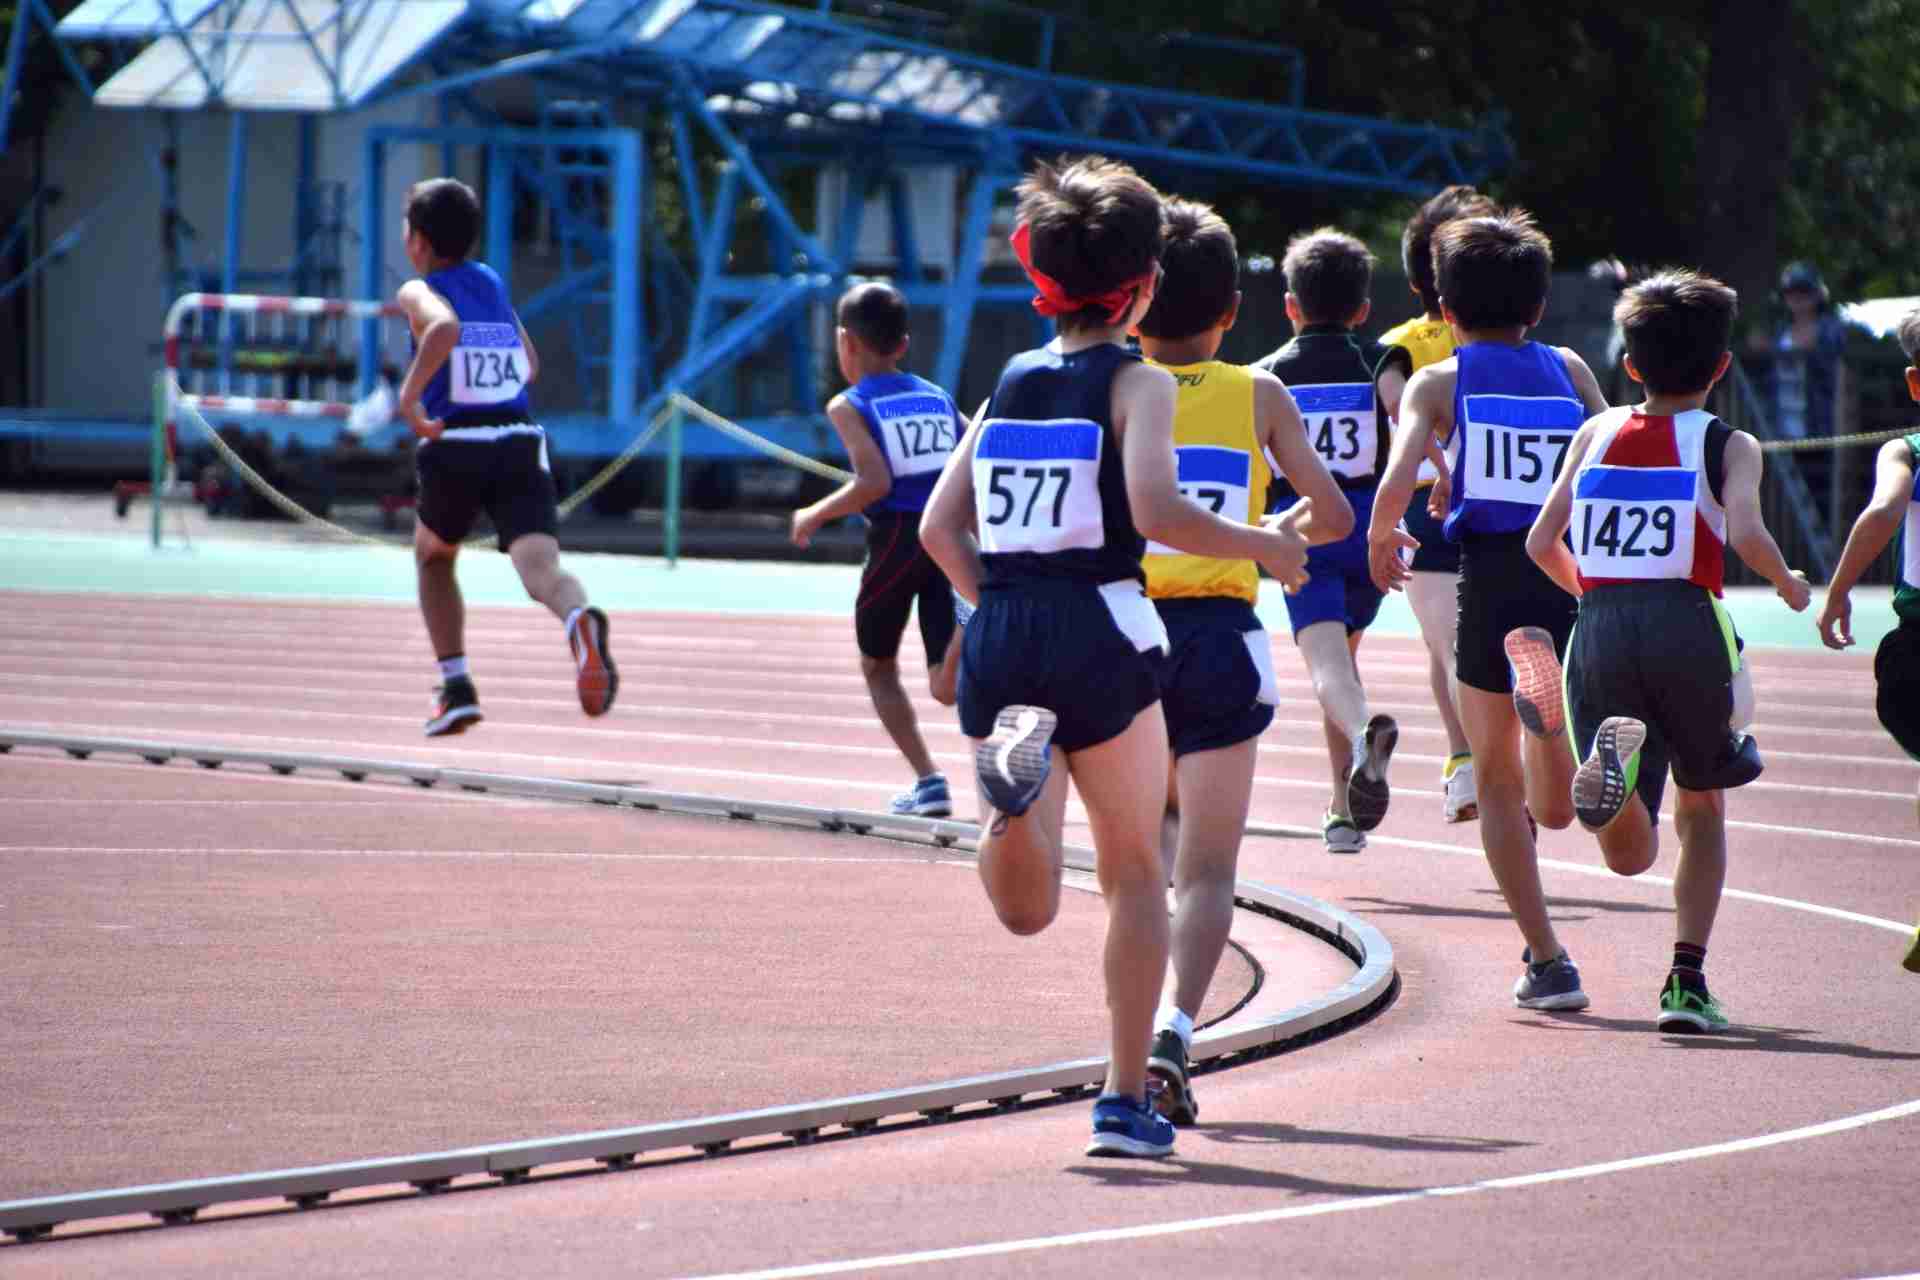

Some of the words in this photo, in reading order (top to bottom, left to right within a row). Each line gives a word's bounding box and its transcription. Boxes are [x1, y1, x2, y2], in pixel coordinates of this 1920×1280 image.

[464, 351, 520, 388] 1234
[896, 419, 955, 458] 1225
[1485, 429, 1573, 484] 1157
[986, 465, 1071, 527] 577
[1581, 504, 1676, 557] 1429
